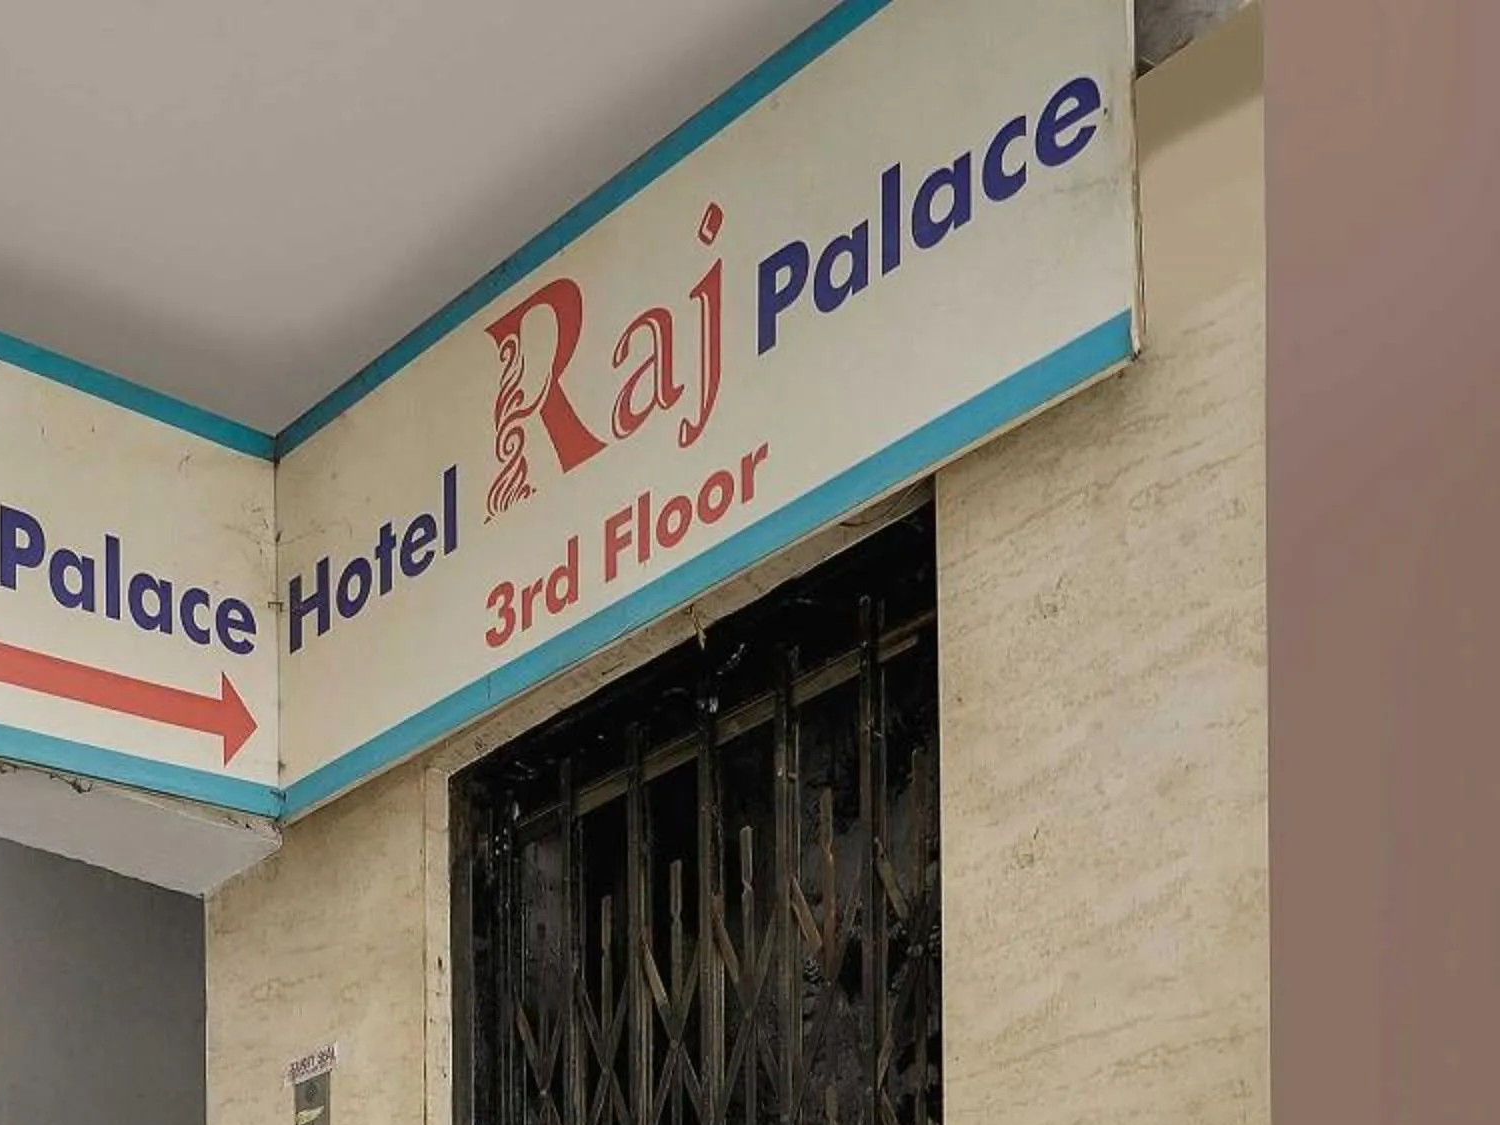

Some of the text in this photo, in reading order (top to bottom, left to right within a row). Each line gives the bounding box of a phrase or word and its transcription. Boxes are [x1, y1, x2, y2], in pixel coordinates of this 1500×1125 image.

[289, 75, 1100, 654] Hotel Raj Palace
[0, 504, 256, 655] Palace
[485, 443, 768, 648] 3rd Floor
